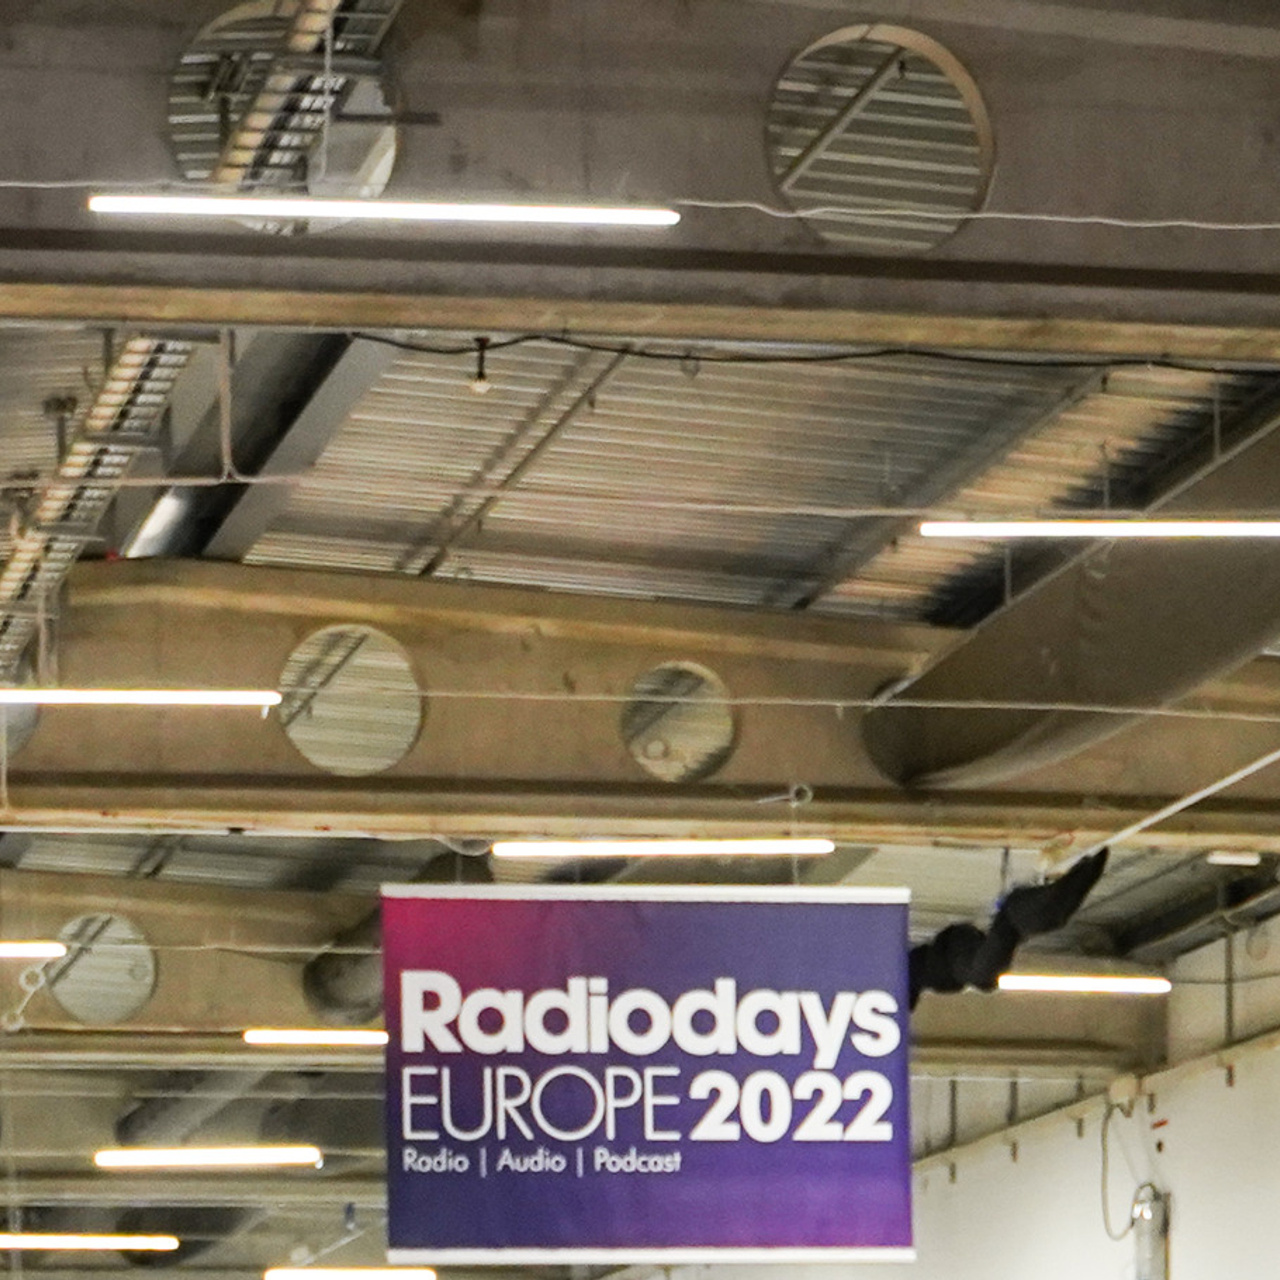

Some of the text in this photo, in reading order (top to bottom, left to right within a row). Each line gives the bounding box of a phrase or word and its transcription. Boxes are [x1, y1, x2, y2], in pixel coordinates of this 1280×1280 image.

[400, 969, 901, 1069] Radiodays
[401, 1065, 893, 1142] EUROPE 2022
[402, 1145, 470, 1174] Radio
[496, 1145, 568, 1173] Audio
[593, 1145, 682, 1173] Podcast
